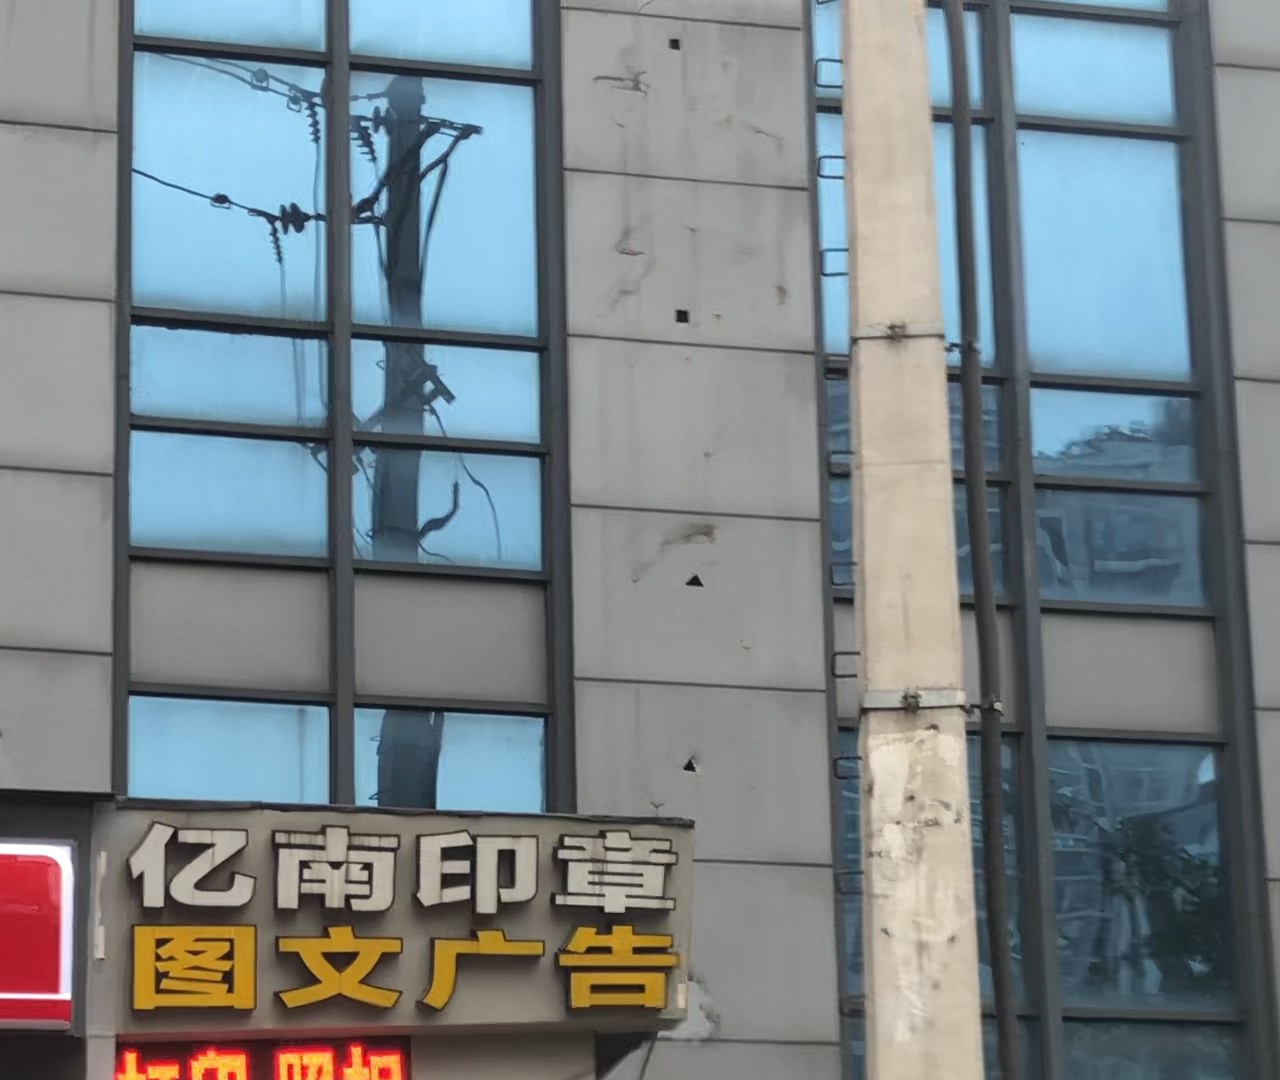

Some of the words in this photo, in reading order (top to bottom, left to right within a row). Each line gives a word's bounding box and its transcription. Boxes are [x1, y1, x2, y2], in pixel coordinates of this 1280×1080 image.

[128, 822, 680, 915] 亿南印章
[131, 924, 680, 1011] 图文广告
